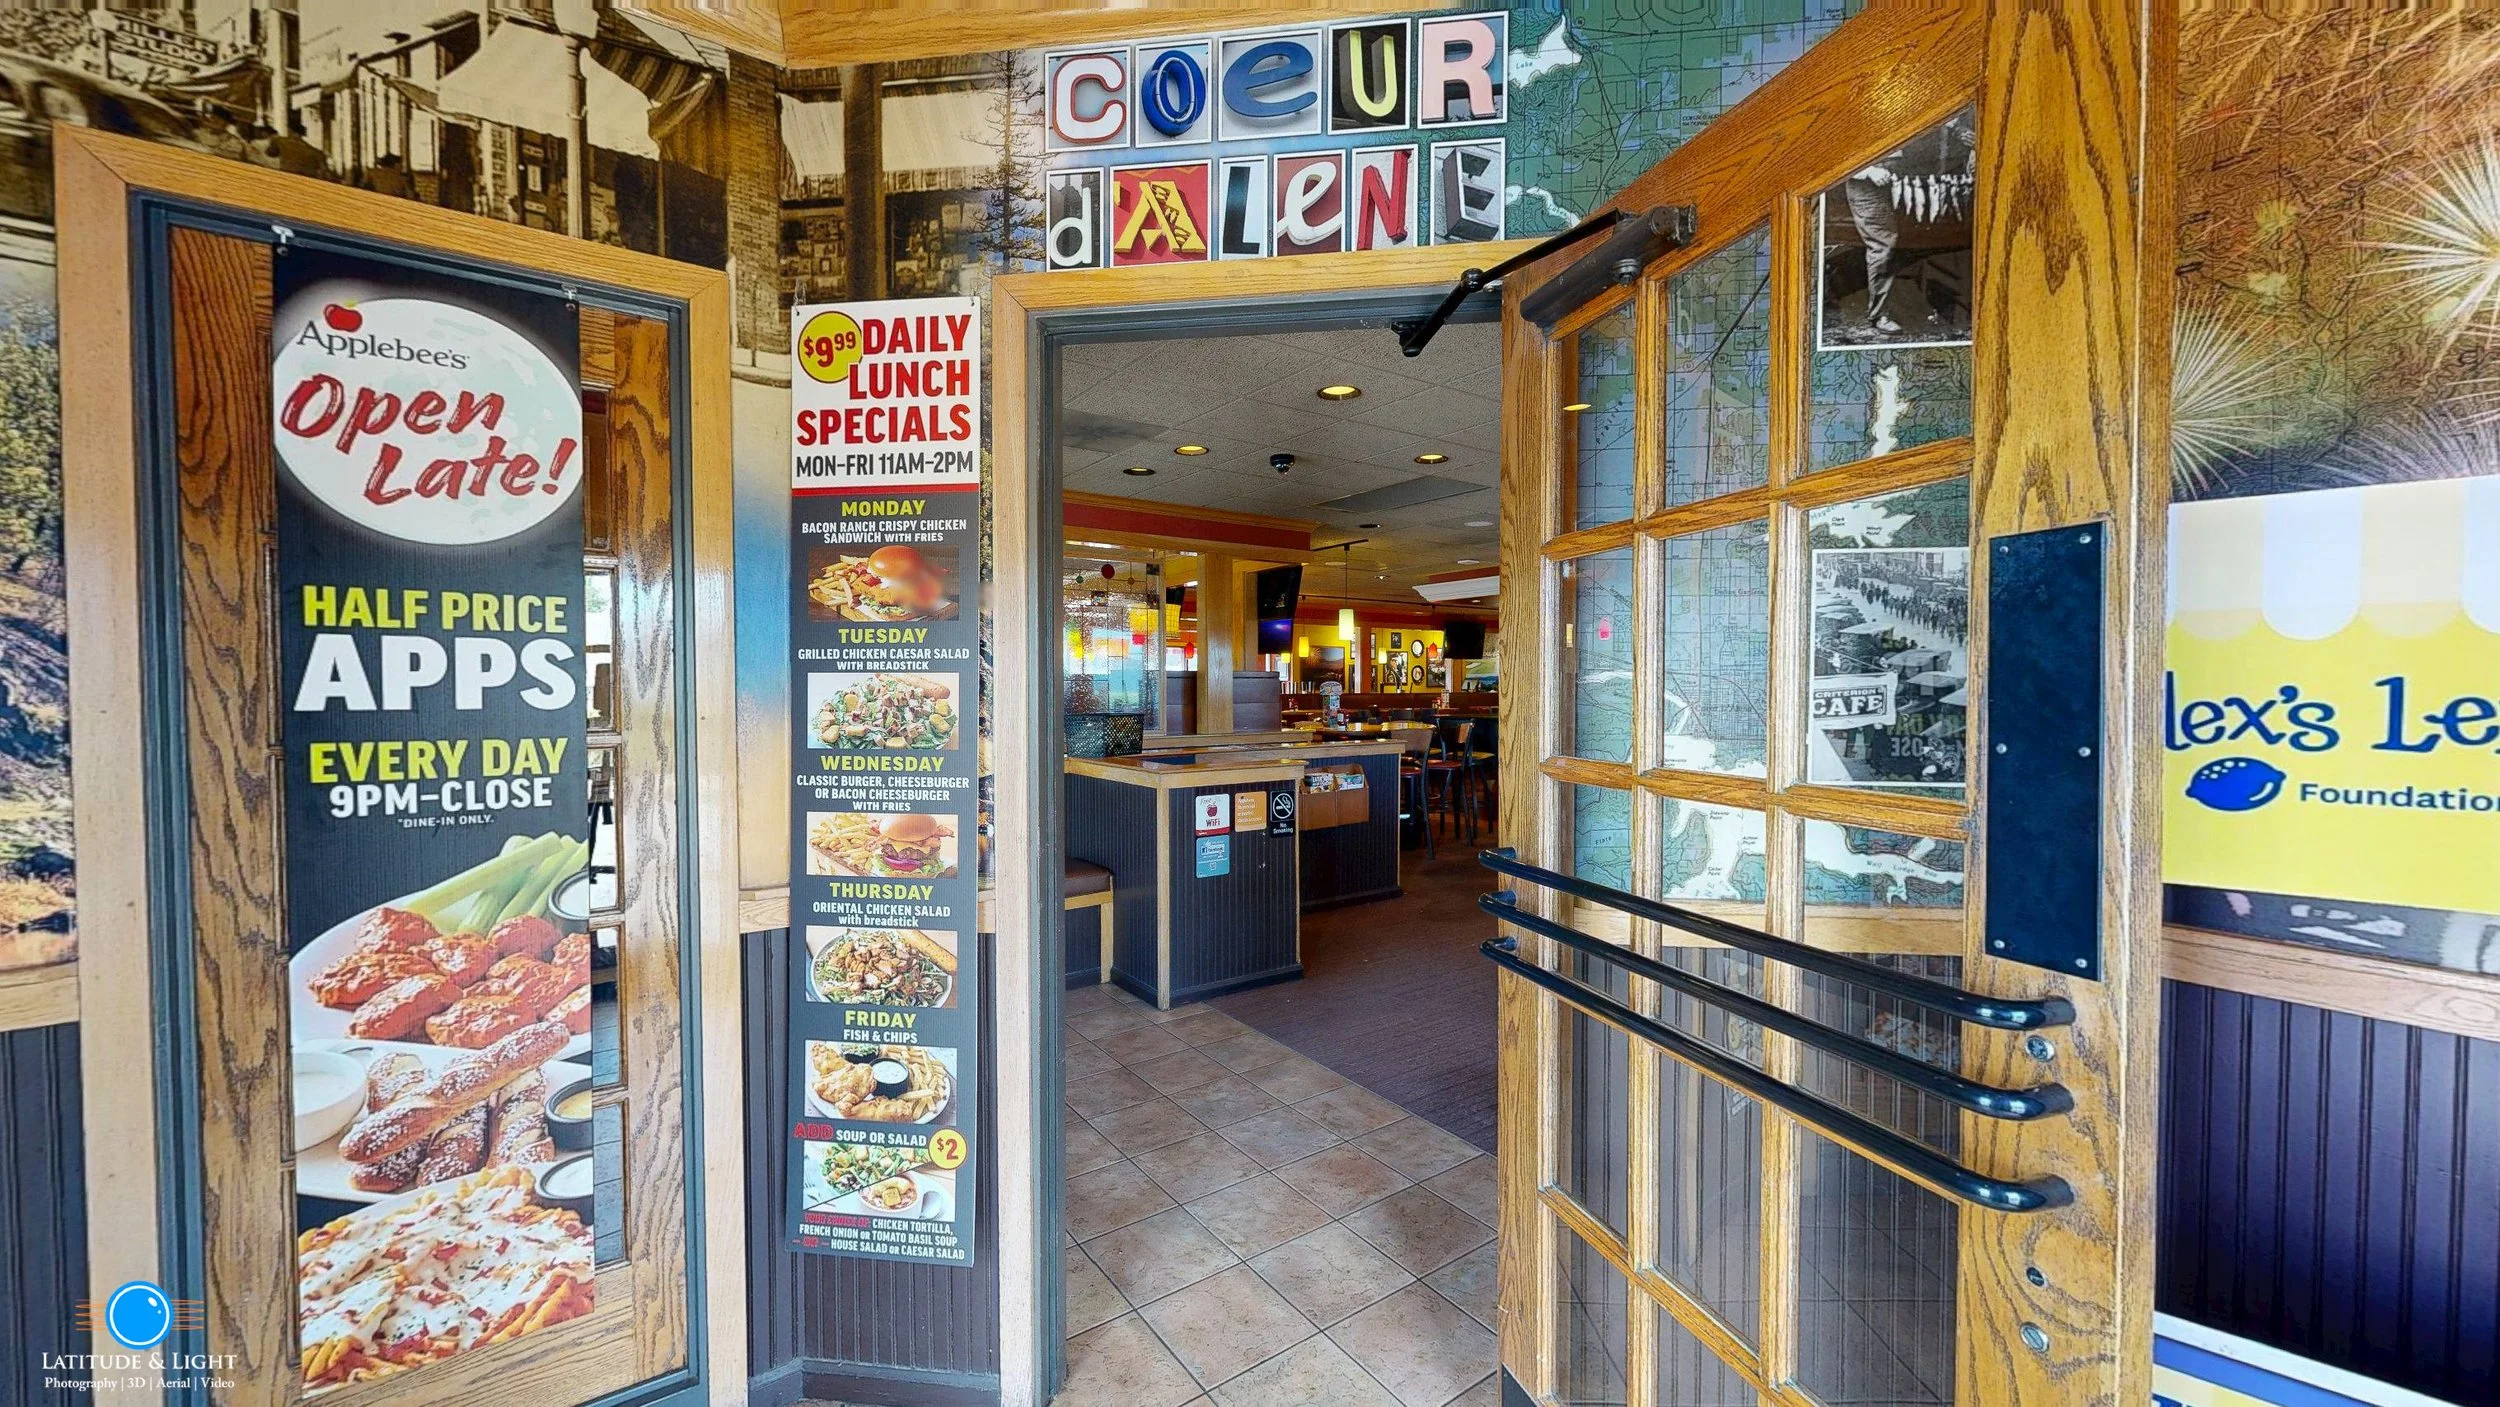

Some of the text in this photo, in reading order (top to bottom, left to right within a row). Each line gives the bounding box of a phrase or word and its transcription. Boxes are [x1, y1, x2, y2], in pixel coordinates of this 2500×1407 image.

[863, 314, 972, 355] DAILY
[297, 320, 469, 370] Applebee's
[849, 359, 970, 400] LUNCH
[280, 374, 504, 454] Open
[796, 403, 972, 446] SPECIALS
[364, 436, 577, 505] Late!
[841, 499, 926, 517] MONDAY
[802, 519, 967, 533] BACON RANCH CRISPY CHICKEN
[824, 532, 943, 544] SANDWICH WITH FRIES
[303, 585, 568, 633] HALF PRICE
[838, 628, 928, 644] TUESDAY
[798, 648, 970, 660] GRILLED CHICKEN CAESAR SALAD
[294, 633, 576, 711] APPS
[837, 661, 929, 671] WITH BREADSTICK
[1815, 689, 1876, 698] CRITERION
[1813, 694, 1883, 716] CAFE
[2371, 676, 2500, 753] Le
[310, 738, 569, 784] EVERY DAY
[821, 755, 945, 772] WEDNESDAY
[796, 775, 970, 789] CLASSIC BURGER, CHEESEBURGER
[815, 788, 950, 801] OR BACON CHEESEBURGER
[2300, 784, 2500, 812] Foundatio
[852, 801, 911, 811] WITH FRIES
[459, 814, 494, 826] ONLY.
[829, 882, 934, 900] THURSDAY
[812, 902, 950, 917] ORIENTAL CHICKEN SALAD
[838, 914, 919, 928] with breadstick
[844, 1010, 917, 1028] FRIDAY
[843, 1029, 918, 1044] FISH & CHIPS
[793, 1122, 927, 1146] ADD SOUP OR SALAD
[936, 1137, 959, 1160] $2
[800, 1224, 831, 1236] FRENCH
[833, 1226, 858, 1238] ONION
[872, 1230, 906, 1243] TOMATO
[908, 1233, 933, 1245] BASIL
[934, 1235, 958, 1247] SOUP
[873, 1218, 908, 1231] CHICKEN
[910, 1222, 954, 1235] TORTILLA,
[831, 1239, 858, 1251] HOUSE
[860, 1242, 887, 1254] SALAD
[901, 1245, 934, 1258] CAESAR
[936, 1248, 965, 1260] SALAD
